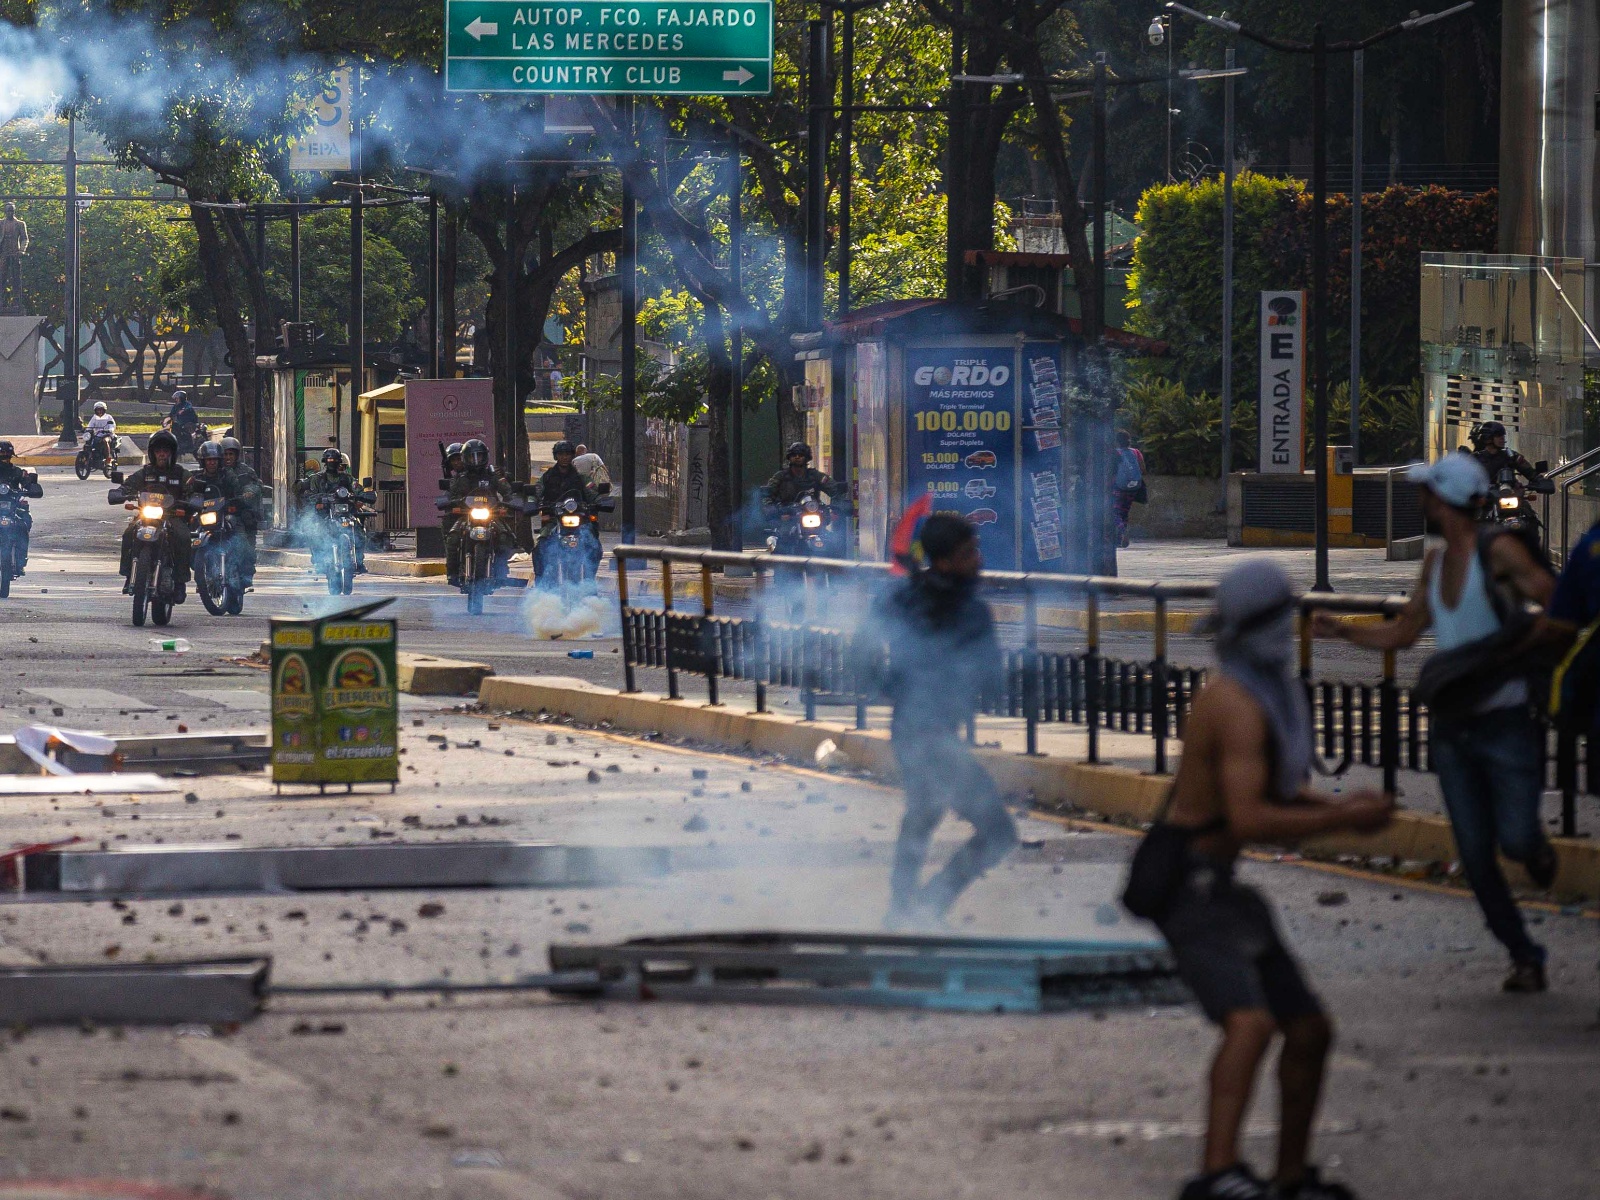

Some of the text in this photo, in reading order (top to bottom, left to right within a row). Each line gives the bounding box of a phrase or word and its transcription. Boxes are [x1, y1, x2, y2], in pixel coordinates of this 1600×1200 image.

[512, 8, 756, 27] AUTOP. FCO. FAJARDO
[512, 33, 684, 51] LAS MERCEDES
[512, 66, 682, 84] COUNTRY CLUB
[308, 142, 341, 156] EPA
[1270, 333, 1294, 360] E
[929, 388, 995, 399] MÁS PREMIOS
[940, 403, 958, 411] Triple
[914, 410, 1011, 431] 100.000
[1272, 368, 1291, 465] ENTRADA
[946, 430, 977, 438] DÓLARES
[922, 452, 959, 464] 15.000
[927, 481, 960, 493] 9.000
